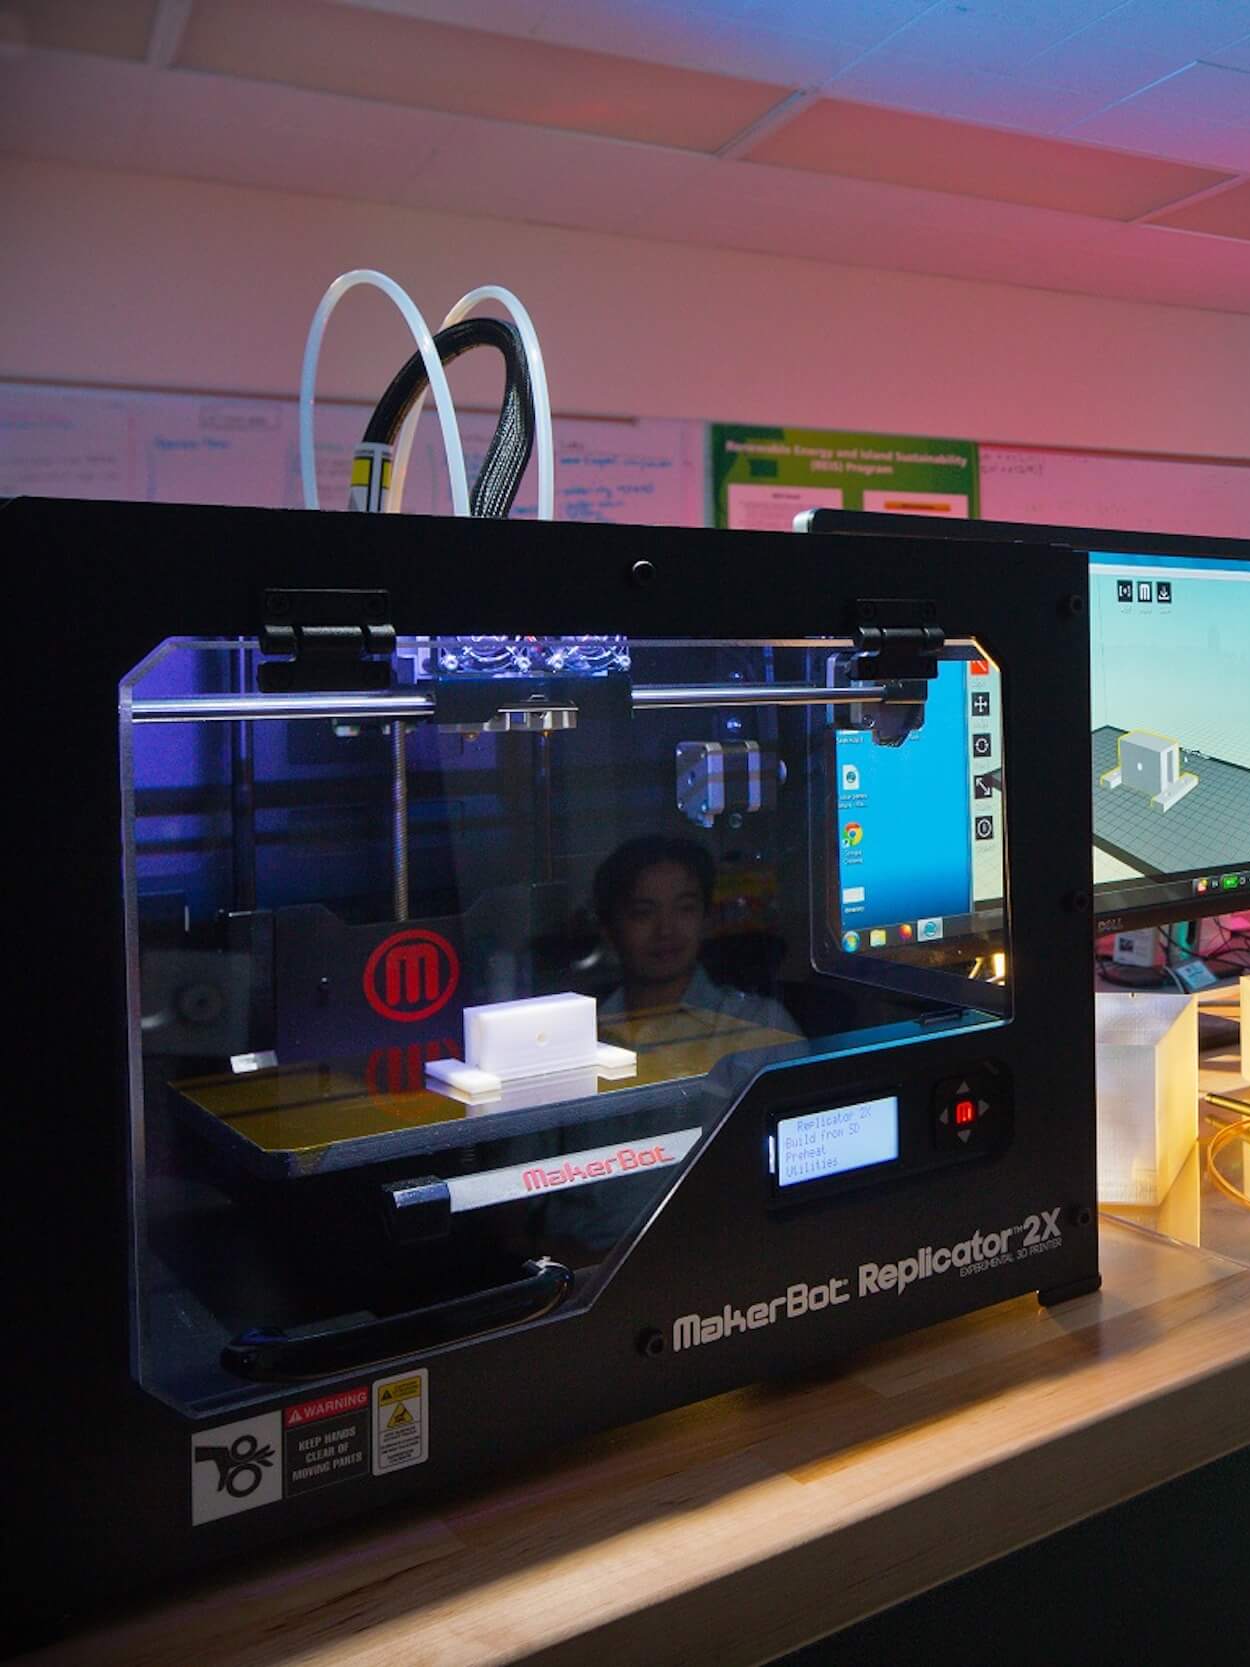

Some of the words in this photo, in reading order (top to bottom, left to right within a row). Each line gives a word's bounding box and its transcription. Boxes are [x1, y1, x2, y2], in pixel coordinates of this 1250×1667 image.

[835, 448, 858, 460] and
[845, 462, 893, 476] Program
[796, 1111, 855, 1132] Replicator
[785, 1133, 816, 1149] Build
[785, 1144, 826, 1163] Preheat
[522, 1147, 675, 1191] MakerBot
[785, 1157, 839, 1178] Utilities
[1029, 1238, 1063, 1256] PRINTER
[672, 1278, 850, 1352] MakerBot
[1024, 1207, 1062, 1247] 2X
[304, 1391, 368, 1419] WARNING
[298, 1436, 322, 1452] KEEP
[324, 1426, 357, 1444] HANDS
[305, 1446, 335, 1463] CLEAR
[337, 1442, 350, 1455] OF
[292, 1461, 331, 1482] MOVING
[332, 1451, 363, 1470] PARTS
